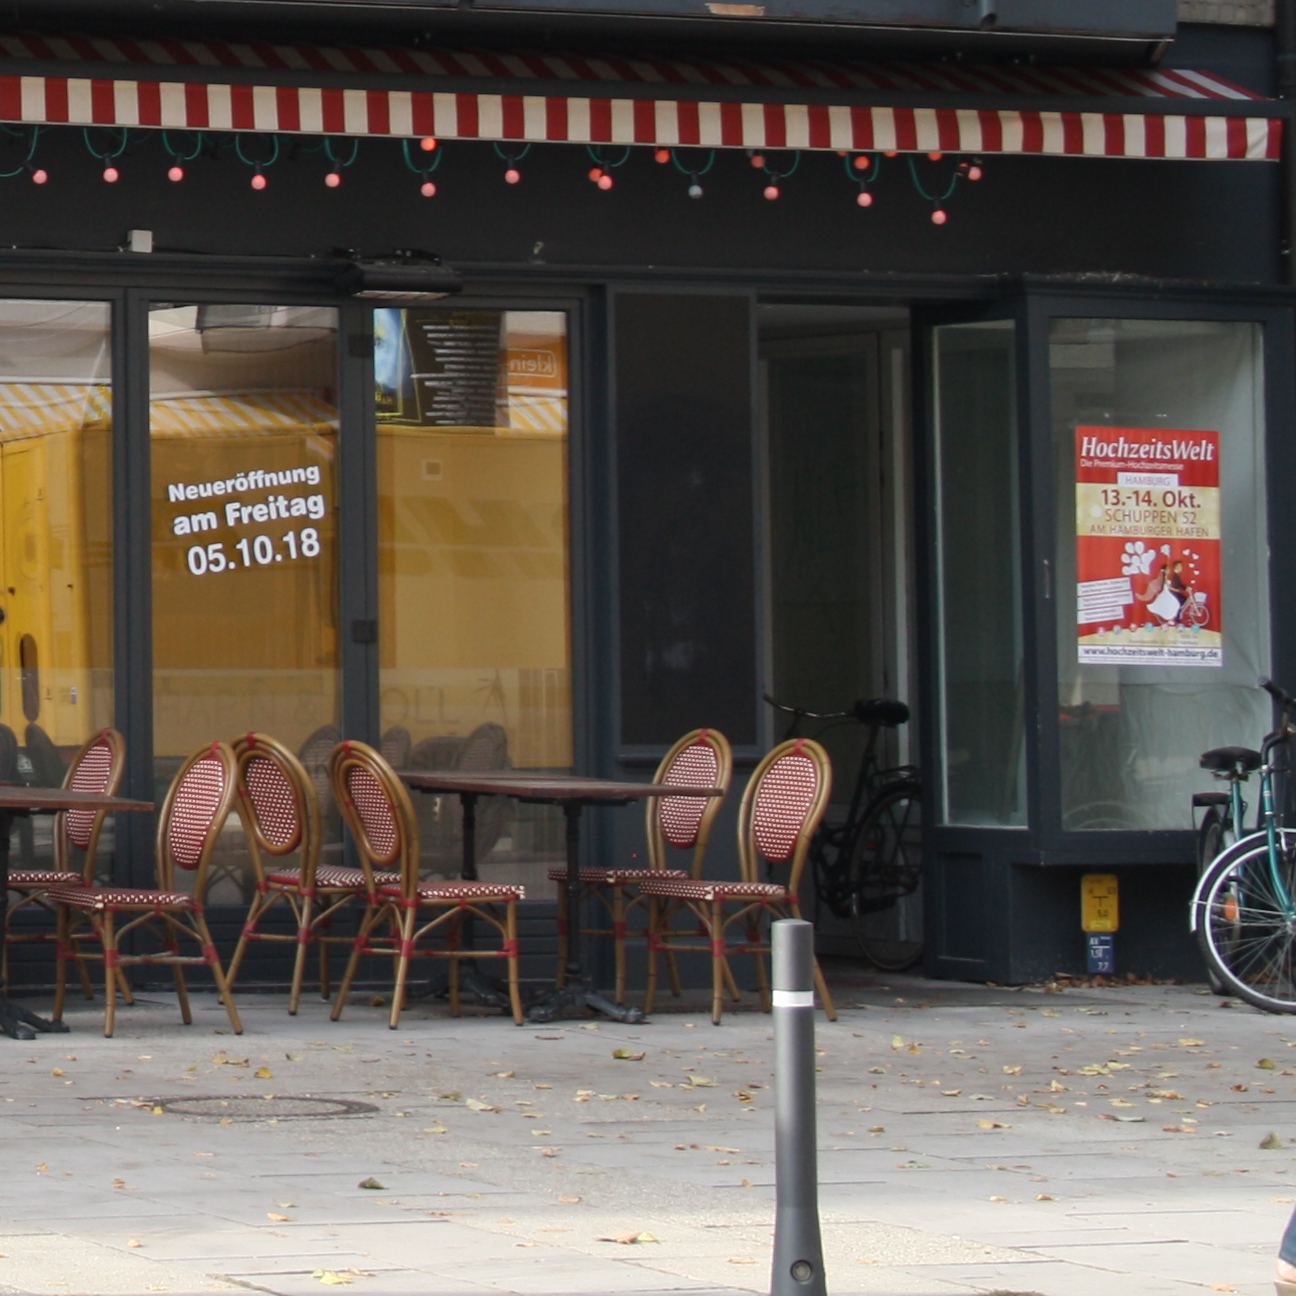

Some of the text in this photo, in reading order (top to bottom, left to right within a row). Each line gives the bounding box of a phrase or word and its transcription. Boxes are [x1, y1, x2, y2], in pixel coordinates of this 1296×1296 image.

[1080, 436, 1215, 461] HochzeitsWelt
[167, 465, 321, 503] Neueröffnung
[1125, 475, 1171, 487] HAMBURG
[1100, 489, 1202, 509] 13.-14. Okt.
[173, 494, 325, 536] am Freitag
[1105, 508, 1178, 524] SCHUPPEN
[1090, 525, 1209, 538] AM HAMBURGER HAFEN
[187, 527, 321, 576] 05.10.18
[1083, 646, 1219, 660] www.hochzeitswelt-hamburg.de
